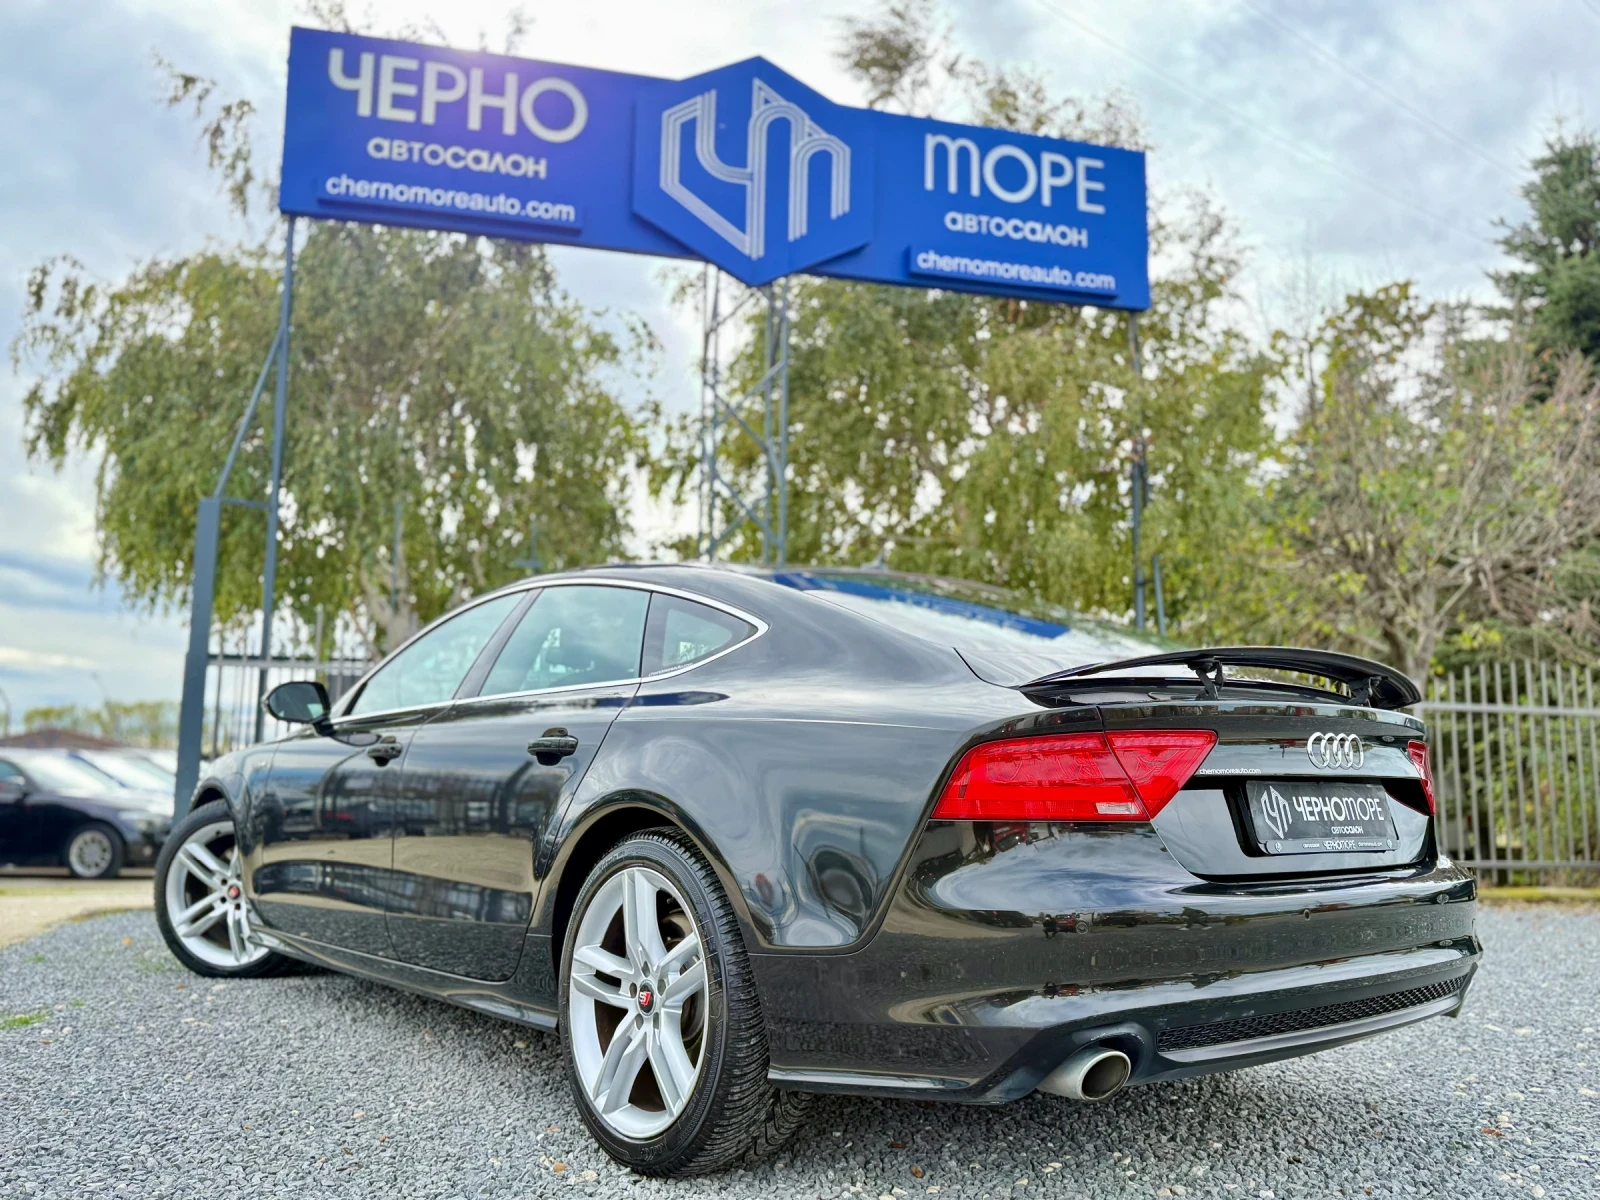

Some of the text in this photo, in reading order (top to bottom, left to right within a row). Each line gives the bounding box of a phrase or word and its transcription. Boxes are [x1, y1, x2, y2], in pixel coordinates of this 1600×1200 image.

[328, 48, 588, 143] ЧЕРНО
[366, 137, 548, 179] автосалон
[325, 174, 575, 222] chernomoreauto.com
[944, 210, 1088, 248] автосалон
[917, 249, 1115, 290] chernomoreauto.com
